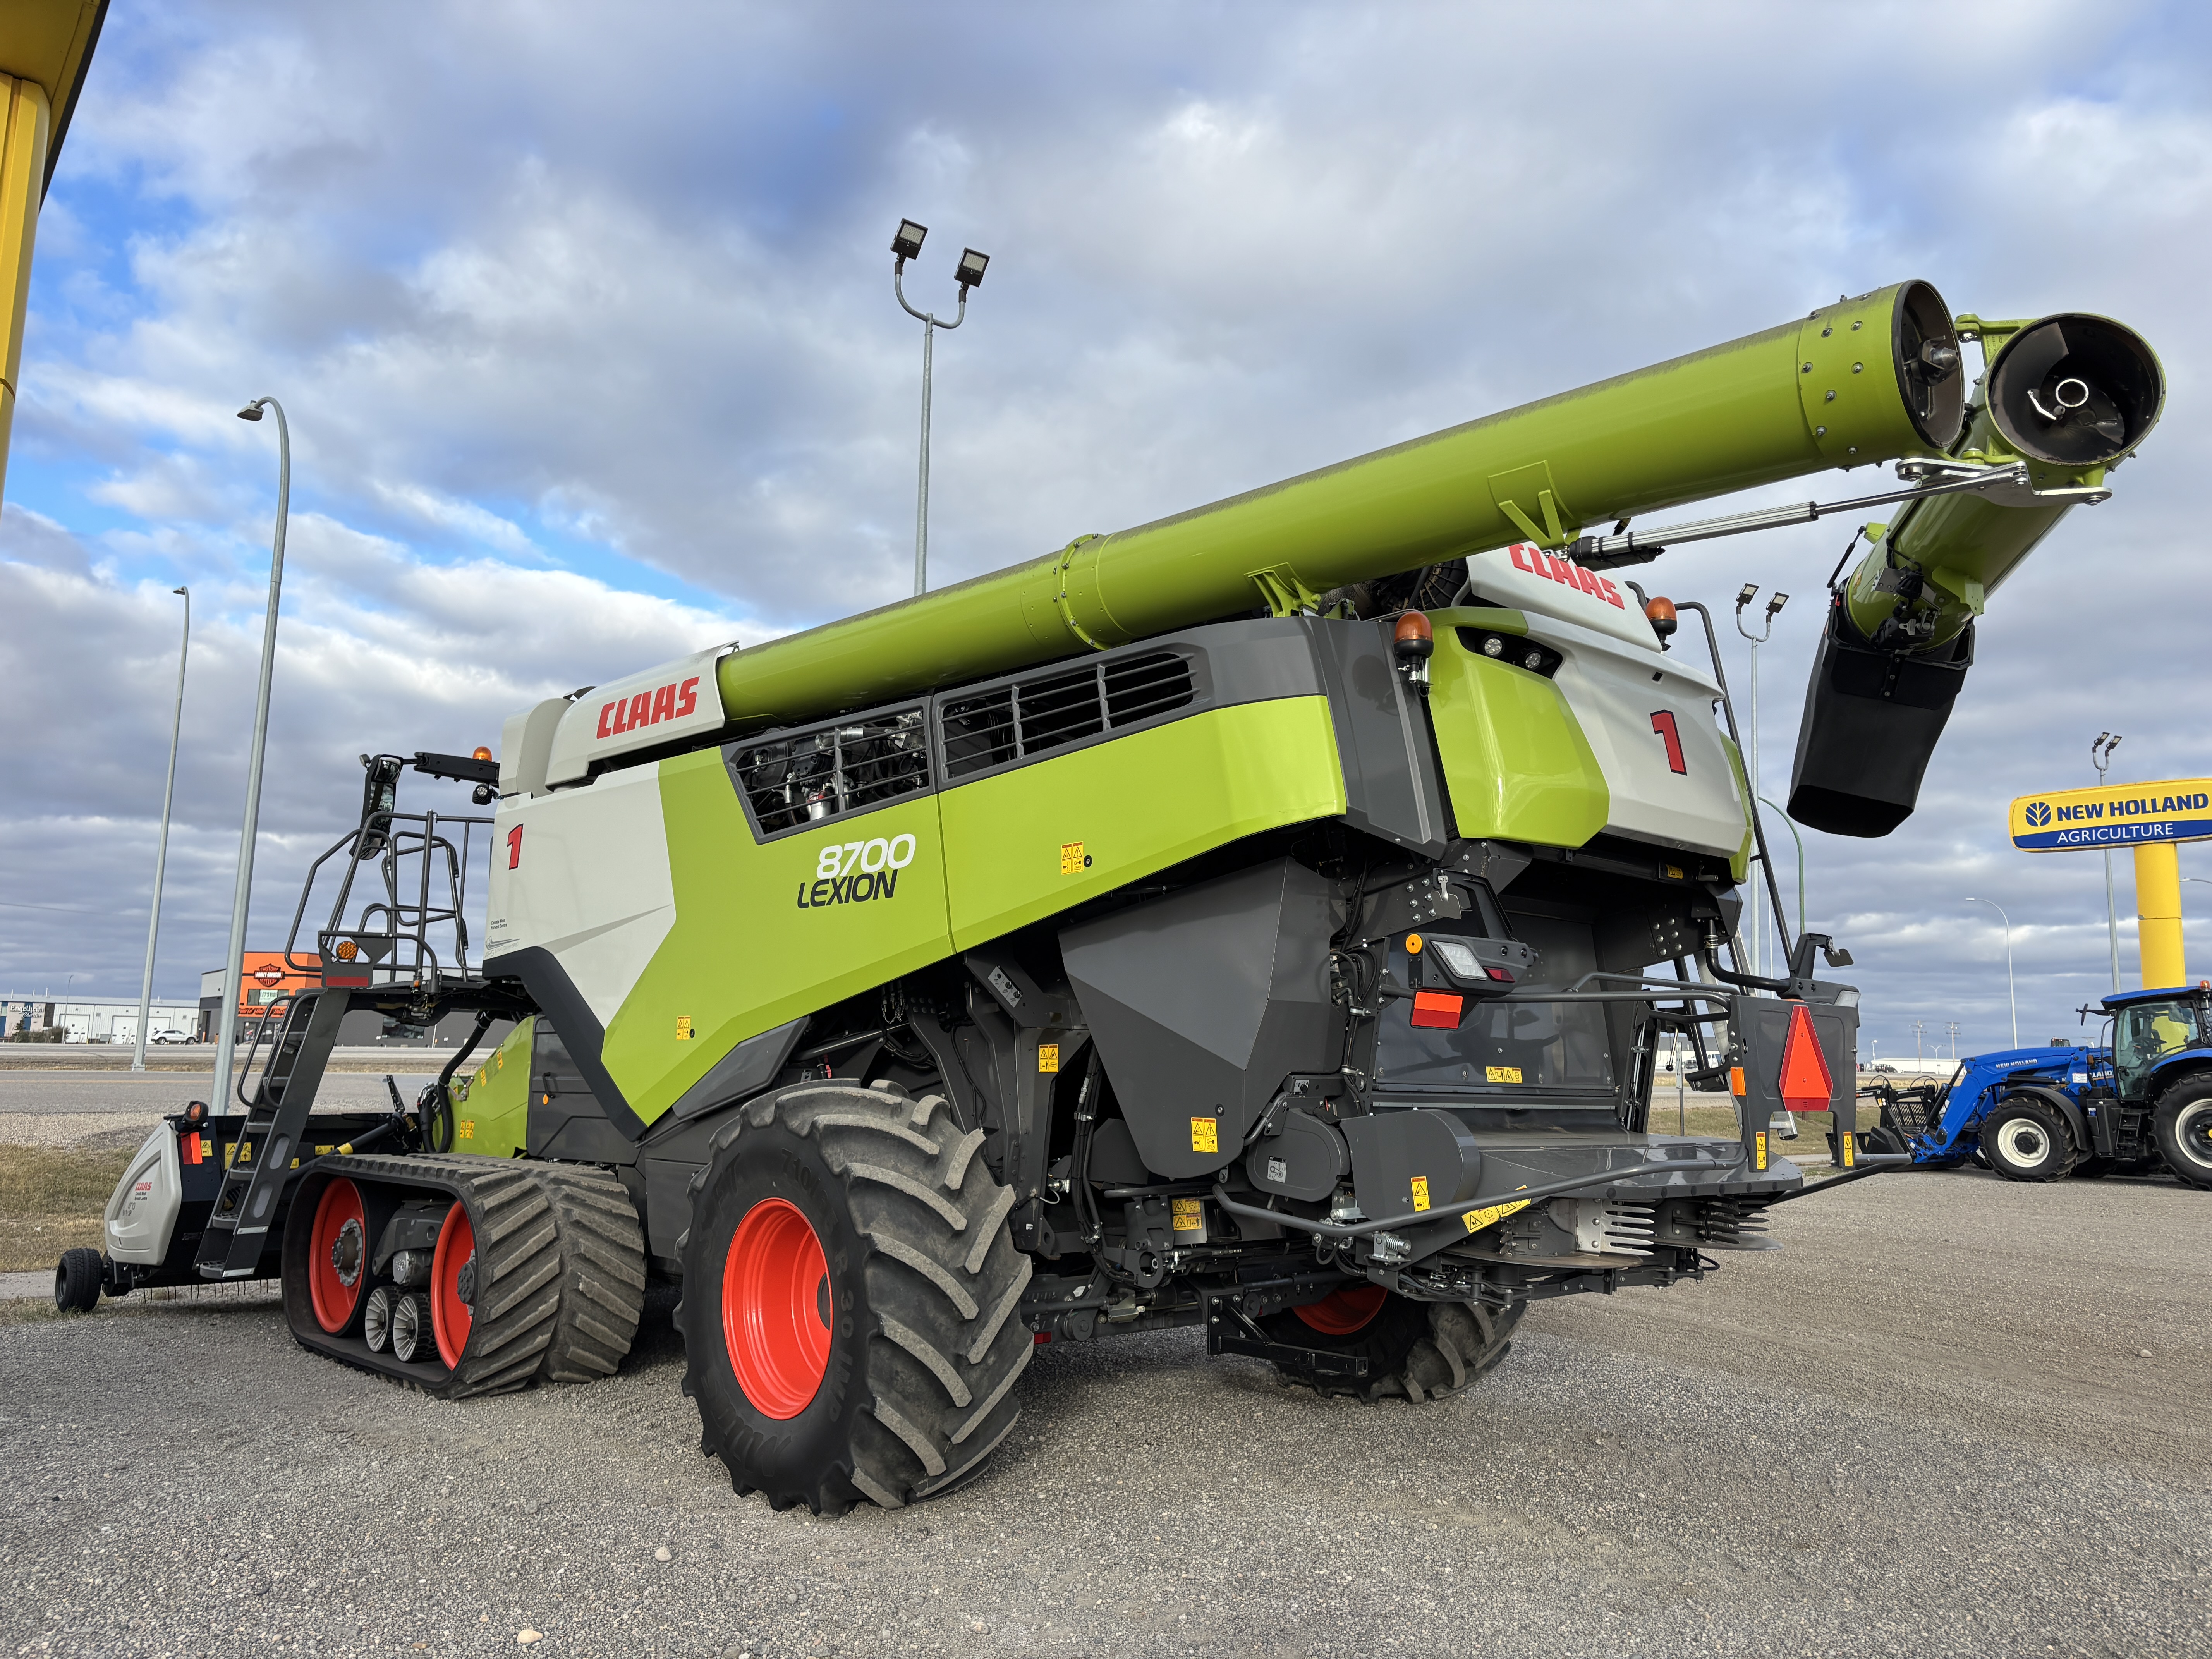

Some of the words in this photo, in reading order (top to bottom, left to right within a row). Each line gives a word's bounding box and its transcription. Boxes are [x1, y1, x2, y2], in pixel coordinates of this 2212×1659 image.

[1509, 544, 1625, 610] CLAAS
[596, 676, 700, 739] CLAAS
[1650, 709, 1688, 776] 1
[2057, 803, 2104, 821] NEW
[2109, 793, 2209, 817] HOLLAND
[507, 823, 524, 870] 1
[816, 833, 917, 879] 8700
[2057, 823, 2174, 843] AGRICULTURE
[797, 869, 898, 909] LEXION
[2010, 1058, 2038, 1066] HOLLAND
[840, 1289, 854, 1339] 30
